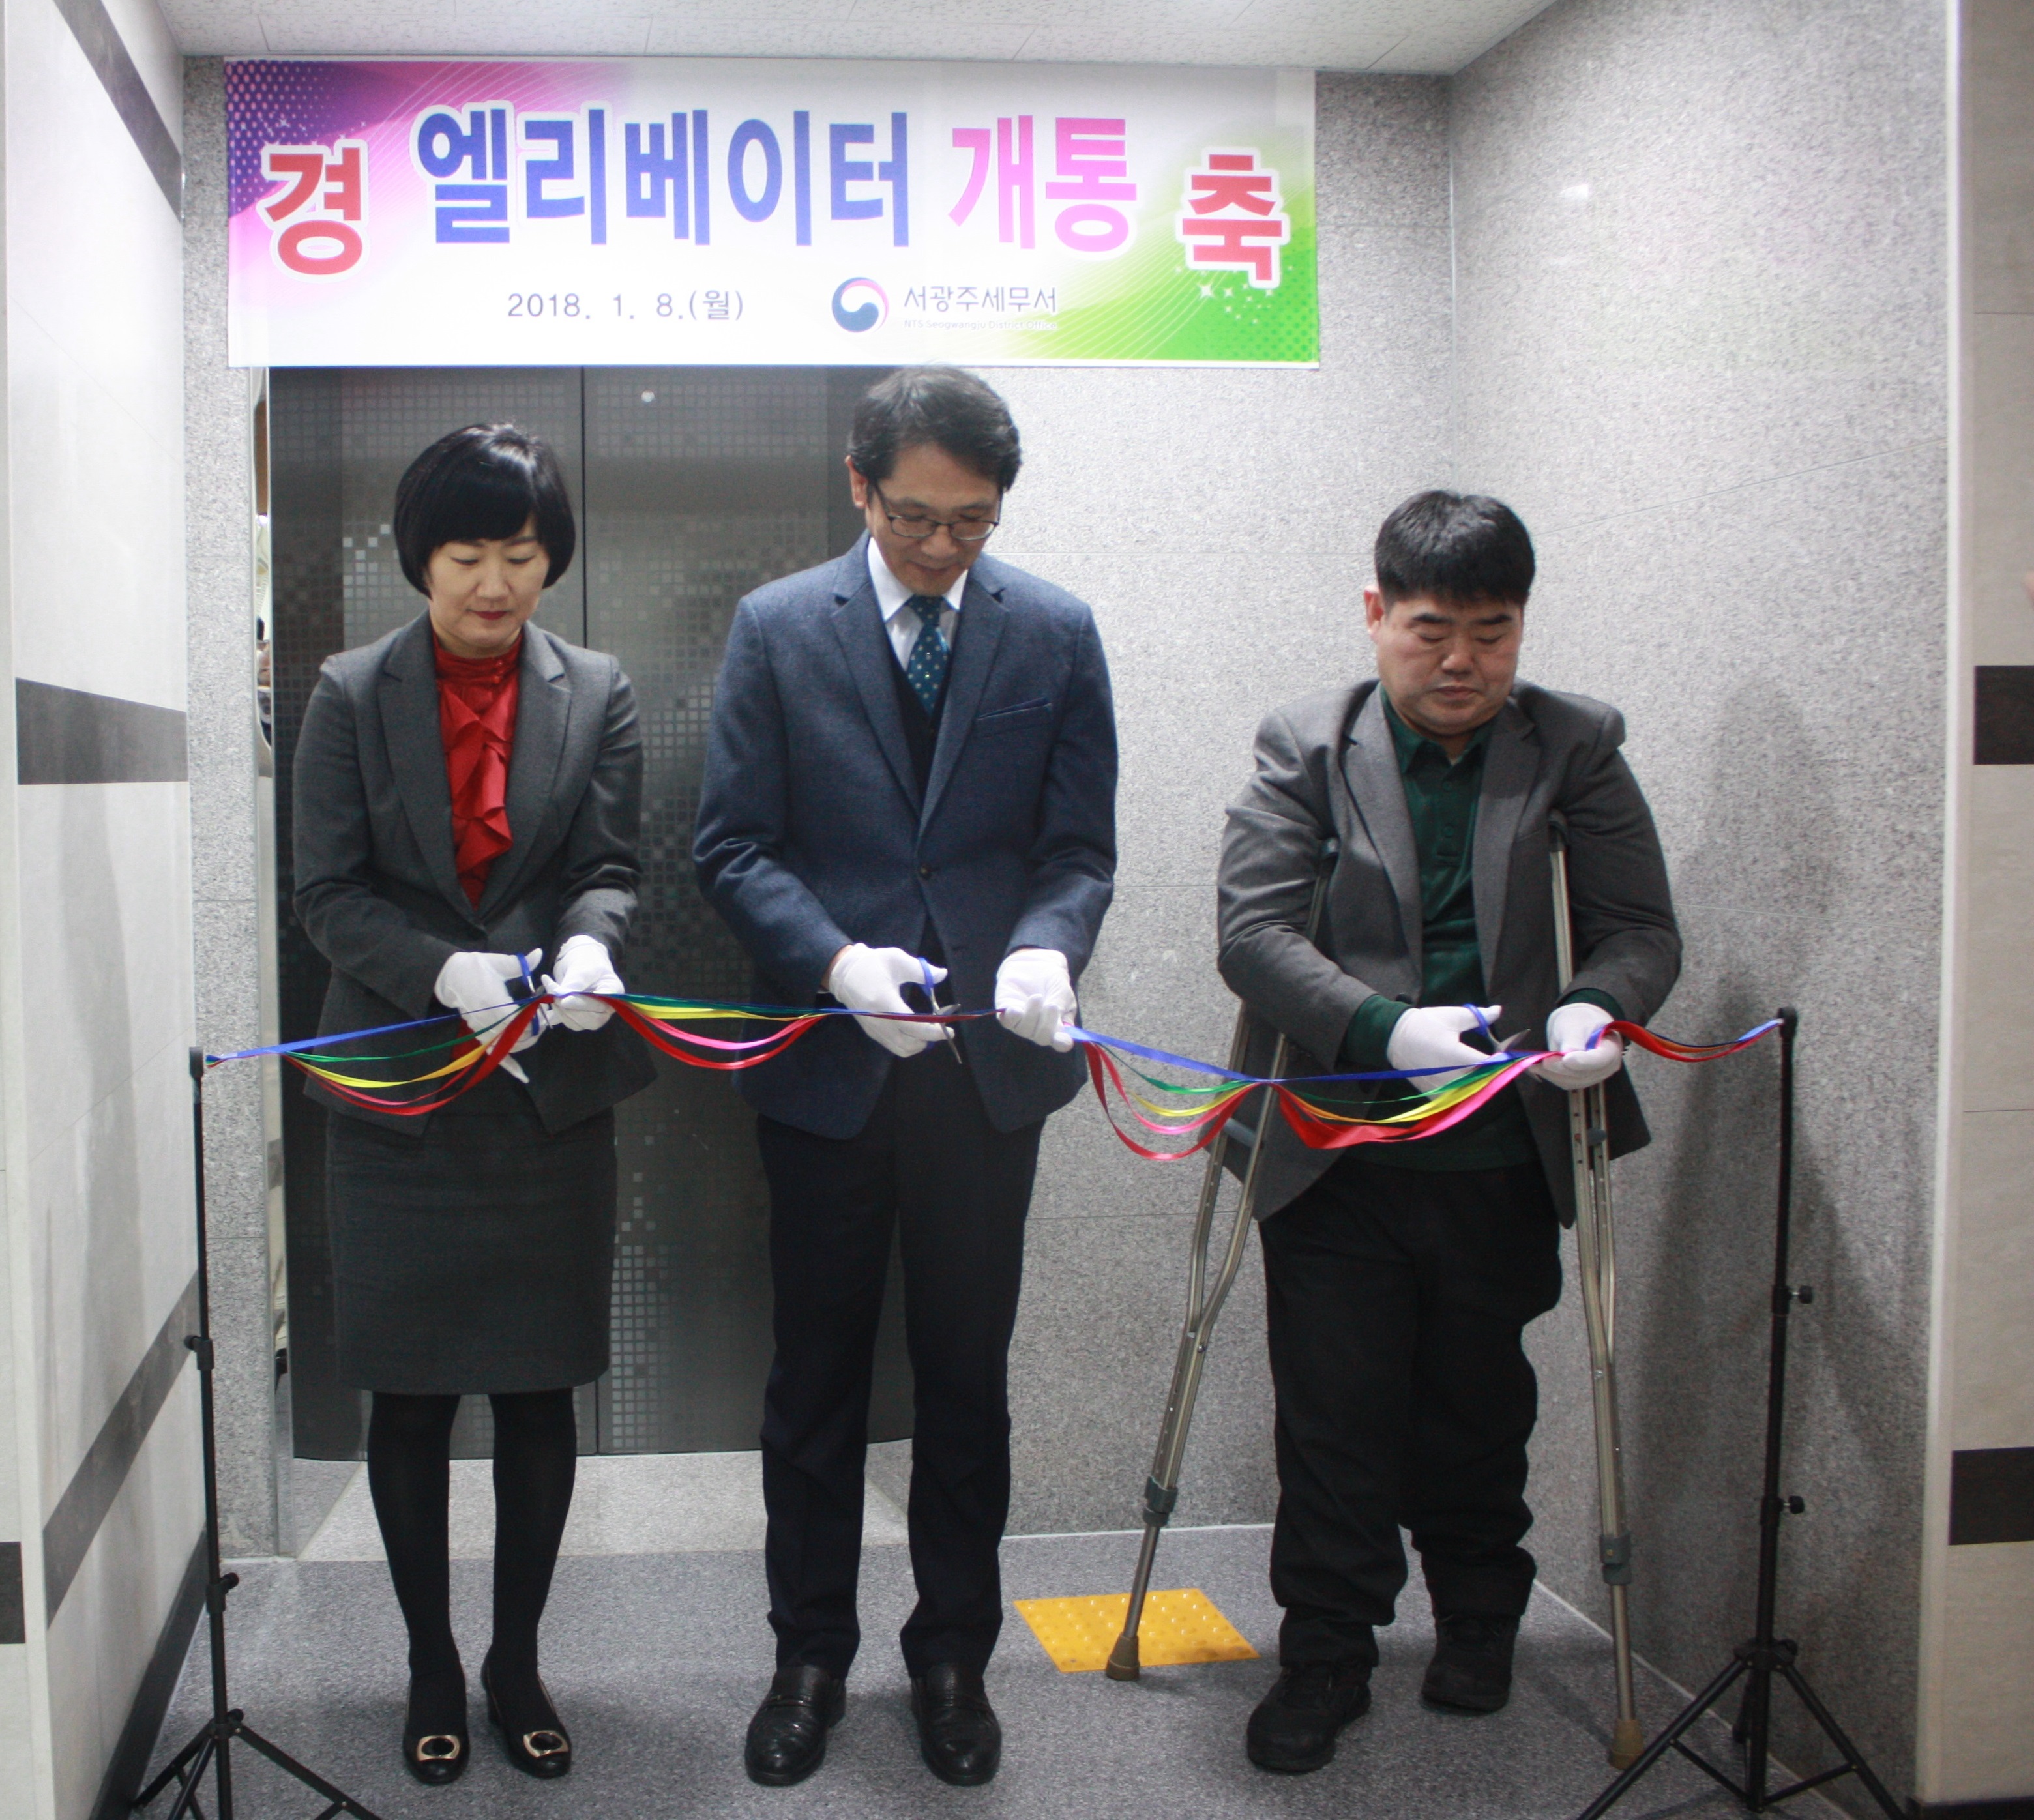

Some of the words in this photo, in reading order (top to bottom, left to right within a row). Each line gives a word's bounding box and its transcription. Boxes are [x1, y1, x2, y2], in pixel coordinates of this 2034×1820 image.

[265, 147, 362, 275] 경
[418, 109, 909, 248] 엘리베이터
[949, 115, 1137, 253] 개통
[1182, 154, 1282, 281] 축
[507, 293, 591, 320] 2018.
[613, 294, 636, 320] 1.
[904, 286, 1056, 312] 서광주세무서
[926, 320, 986, 330] Seogwangju
[989, 320, 1023, 329] District
[1025, 321, 1056, 329] Office
